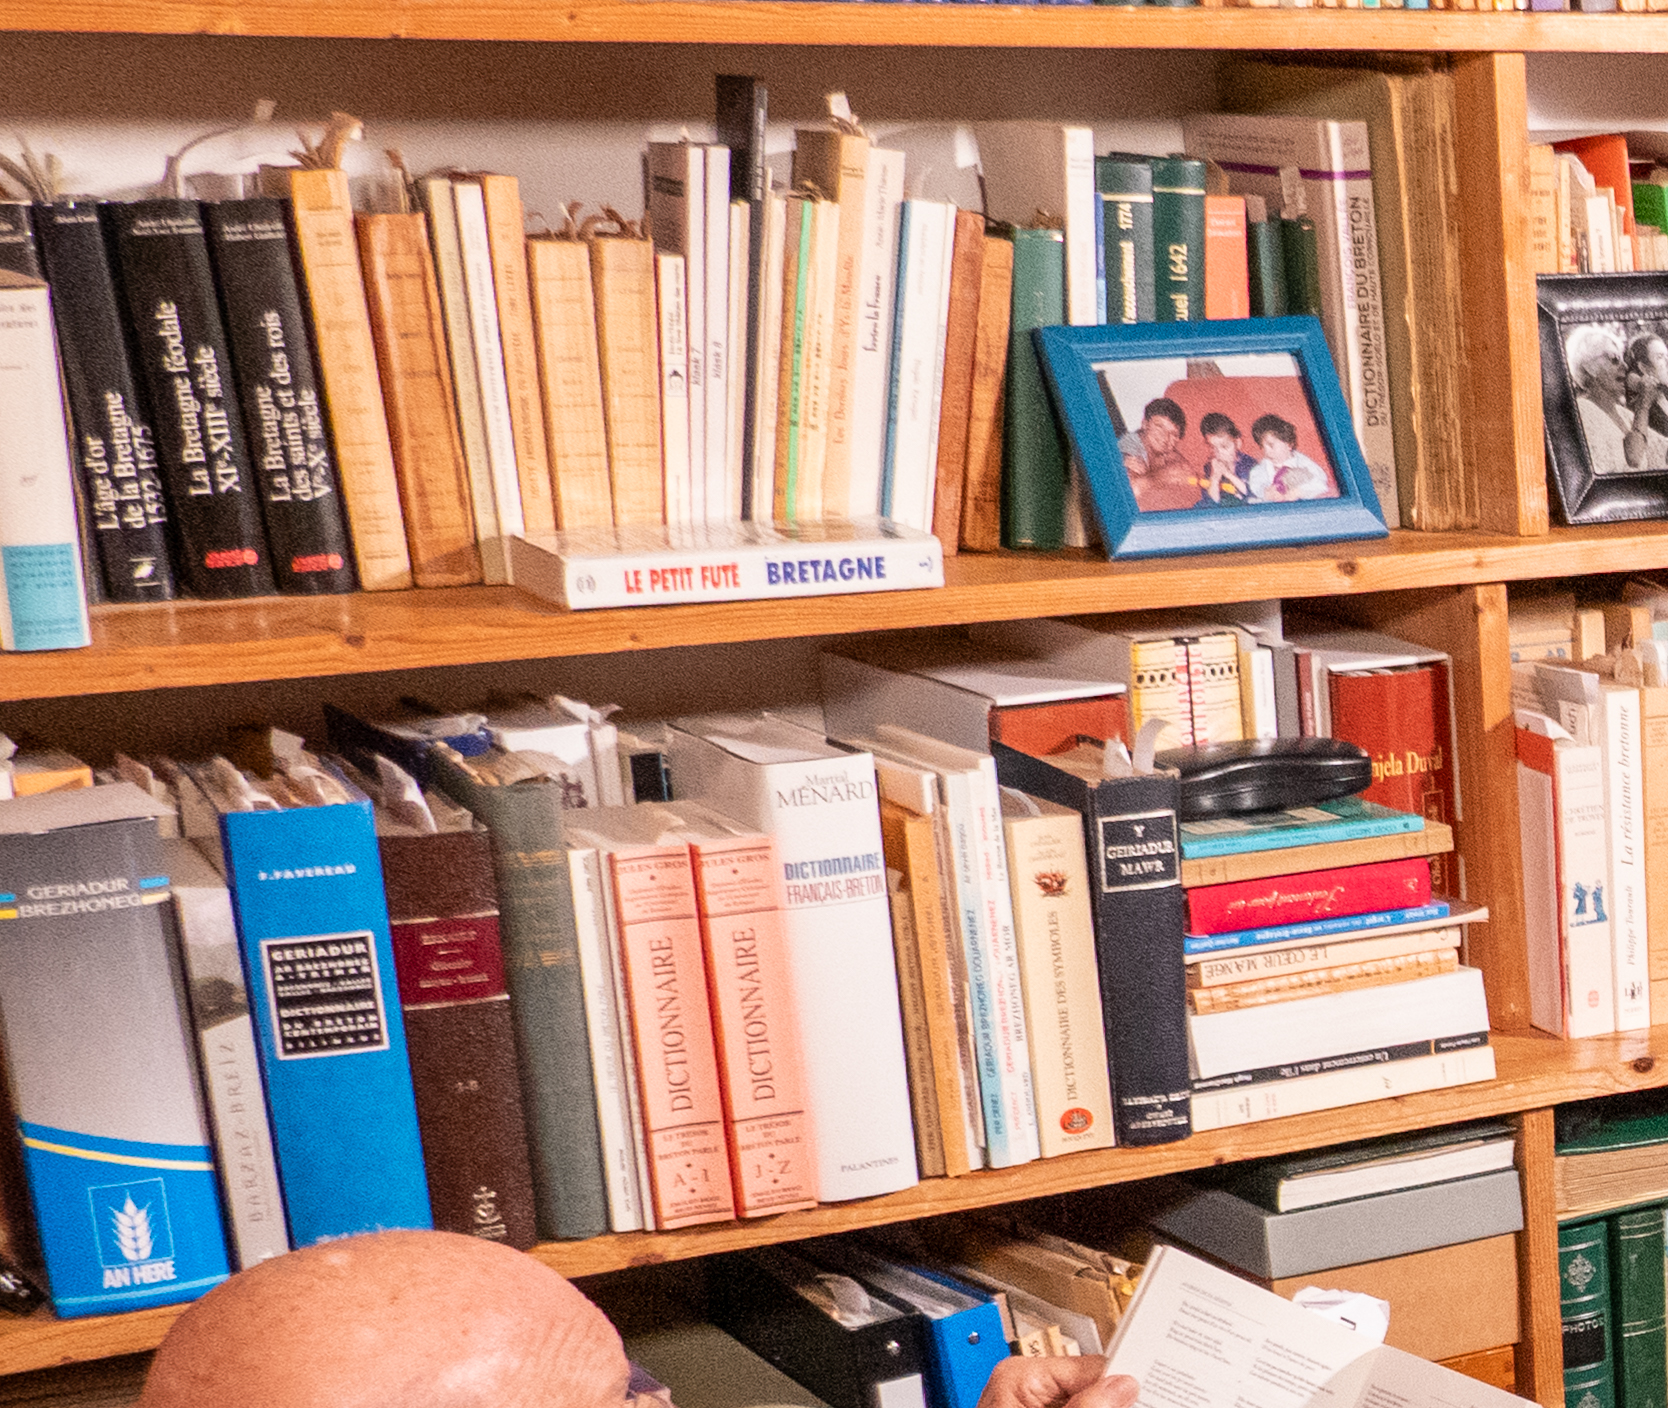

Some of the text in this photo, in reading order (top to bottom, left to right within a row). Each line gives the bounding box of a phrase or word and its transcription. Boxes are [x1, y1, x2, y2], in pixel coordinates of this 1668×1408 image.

[1117, 202, 1133, 231] 1774
[1168, 243, 1189, 282] 1642
[1349, 195, 1380, 428] DICTIONNAIRE DU BRETON
[194, 344, 224, 400] siècle
[154, 300, 214, 497] La Bretagne féodale
[260, 309, 316, 503] des saints et des rois
[297, 387, 326, 442] siècle
[104, 391, 138, 478] Bretagne
[255, 385, 293, 503] La Bretagne
[84, 435, 110, 475] d'or
[119, 481, 141, 501] la
[624, 555, 887, 595] LE PETIT BRETAGNE
[1405, 744, 1444, 776] Duval
[774, 777, 875, 810] MÉNARD
[804, 769, 851, 791] Martial
[1617, 705, 1635, 867] La résistance bretonne
[1133, 824, 1146, 838] Y
[655, 857, 688, 869] GROS
[733, 852, 770, 865] GROS
[1105, 841, 1174, 860] GEIRIADUR
[784, 852, 881, 882] DICTIONNAIRE
[1119, 860, 1164, 876] MAWR
[25, 876, 130, 901] GERIADUR
[786, 873, 885, 906] FRANÇAIS-BRETON
[17, 891, 142, 920] BREZHONEG
[270, 942, 369, 963] GERIADUR
[1263, 950, 1308, 969] CŒUR
[1310, 947, 1329, 962] LE
[279, 1001, 376, 1019] DICTIONNAIRE
[731, 926, 777, 1102] DICTIONNAIRE
[1048, 910, 1079, 1101] DICTIONNAIRE DES SYMBOLES
[648, 935, 695, 1114] DICTIONNAIRE
[1298, 1060, 1321, 1074] dans
[840, 1156, 900, 1174] PALANTINES
[103, 1258, 177, 1289] AN HERE
